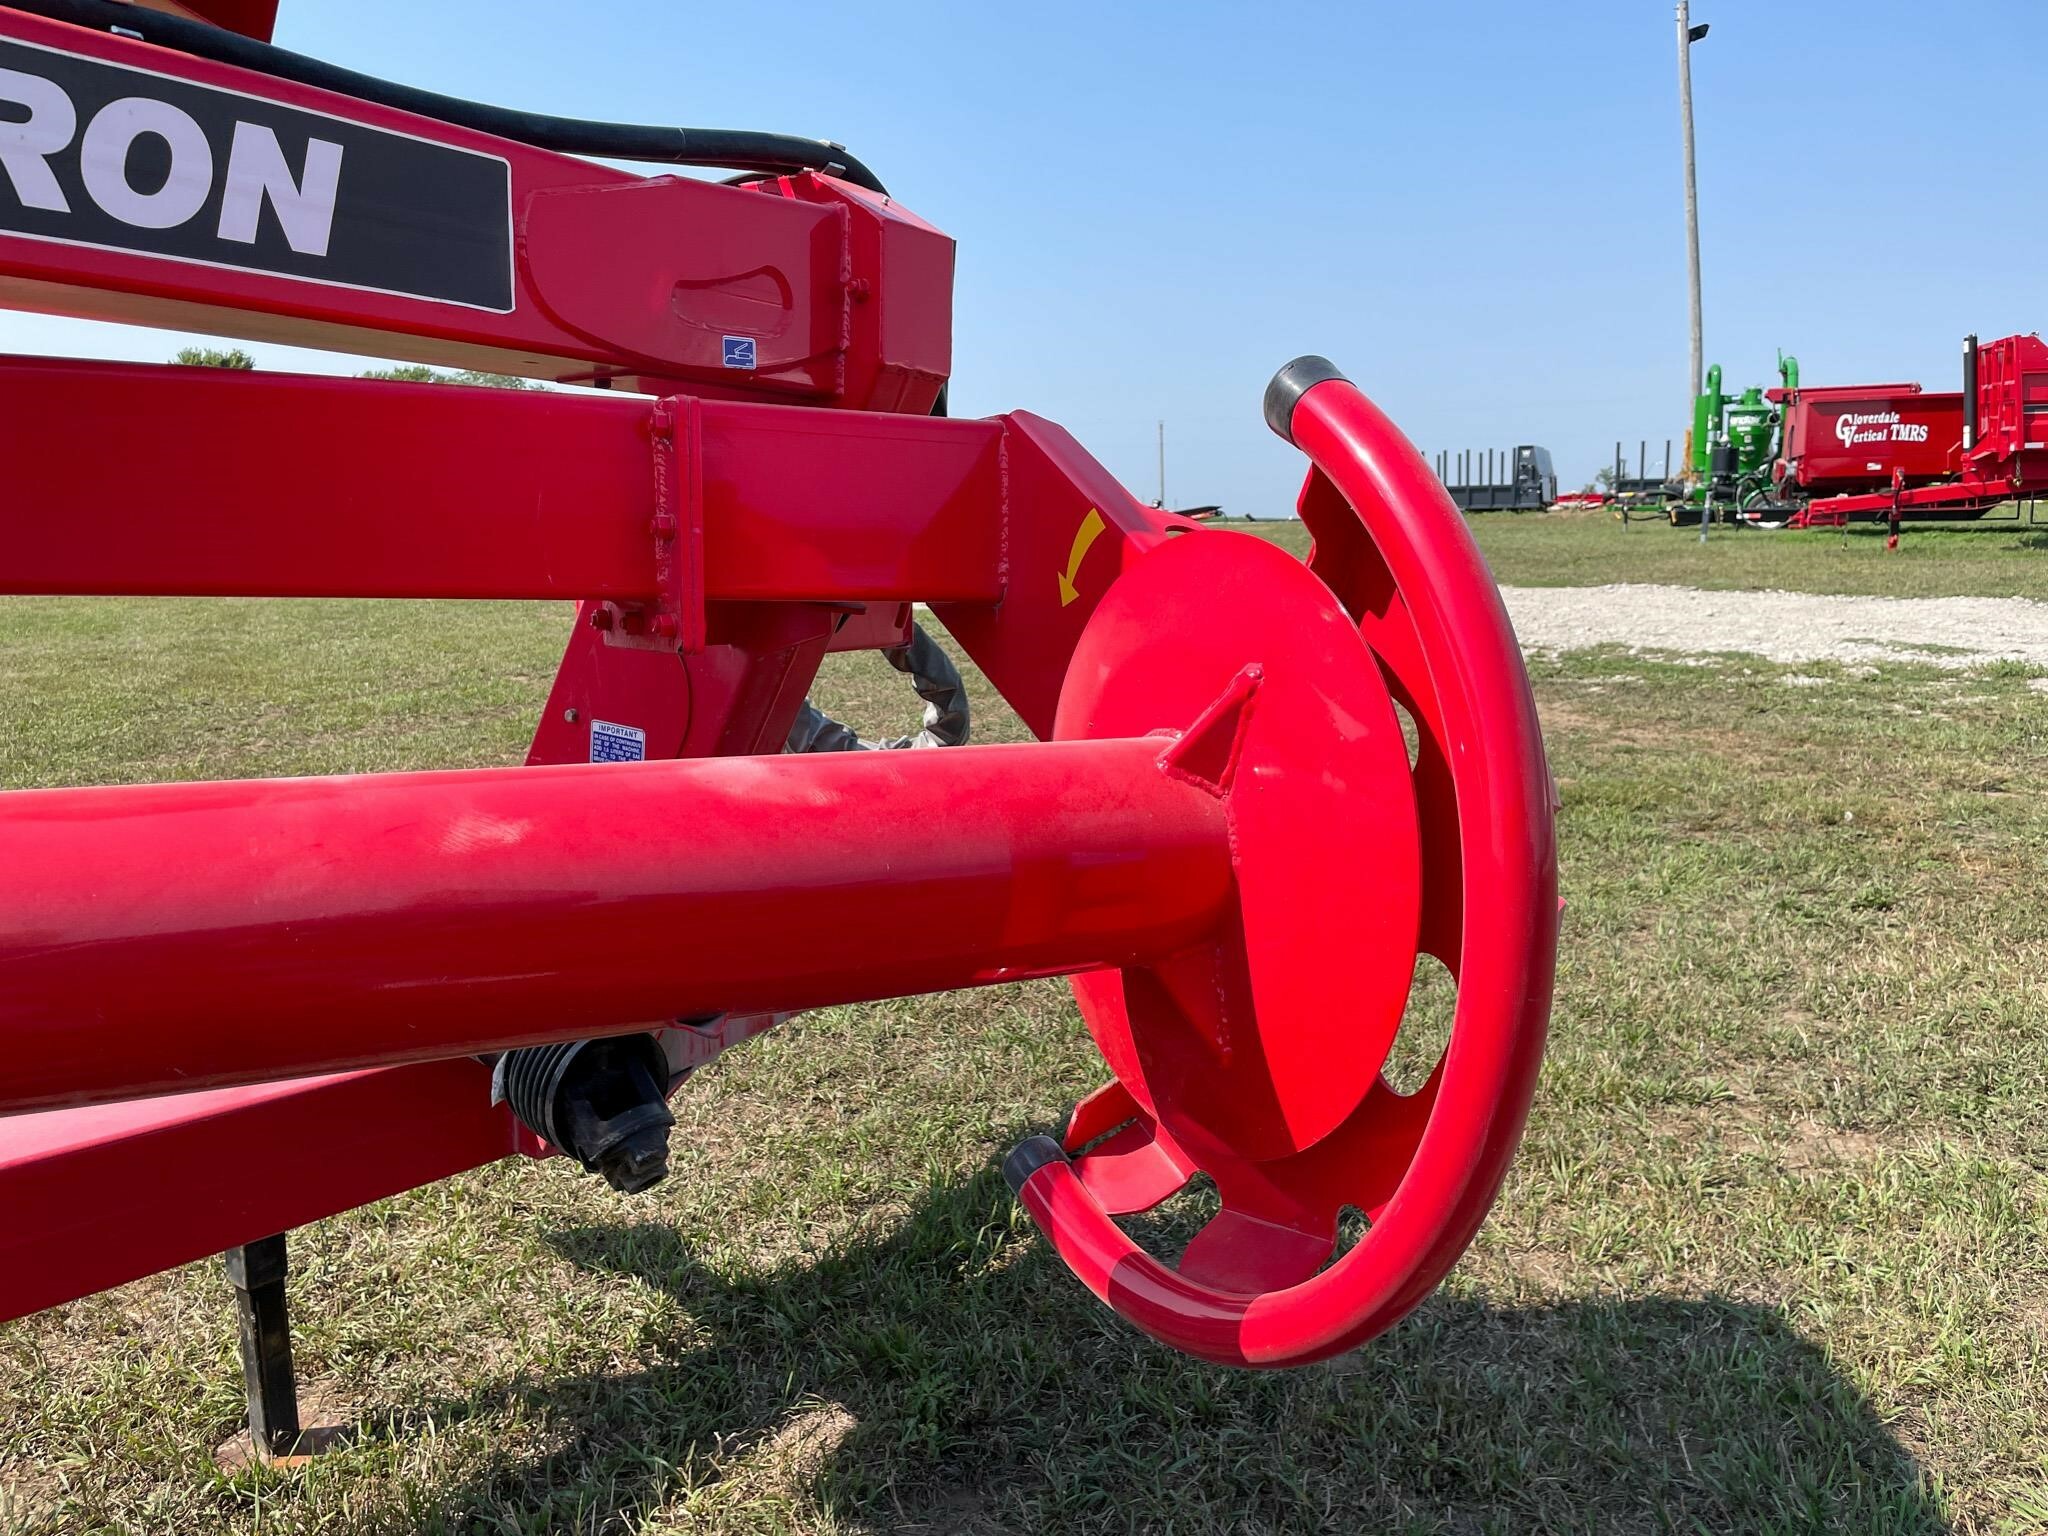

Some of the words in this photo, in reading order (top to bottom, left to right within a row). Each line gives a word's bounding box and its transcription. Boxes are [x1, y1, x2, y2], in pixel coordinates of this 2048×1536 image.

[1842, 425, 1887, 449] Vertical
[1890, 423, 1928, 442] TMRS
[598, 724, 638, 739] IMPORTANT
